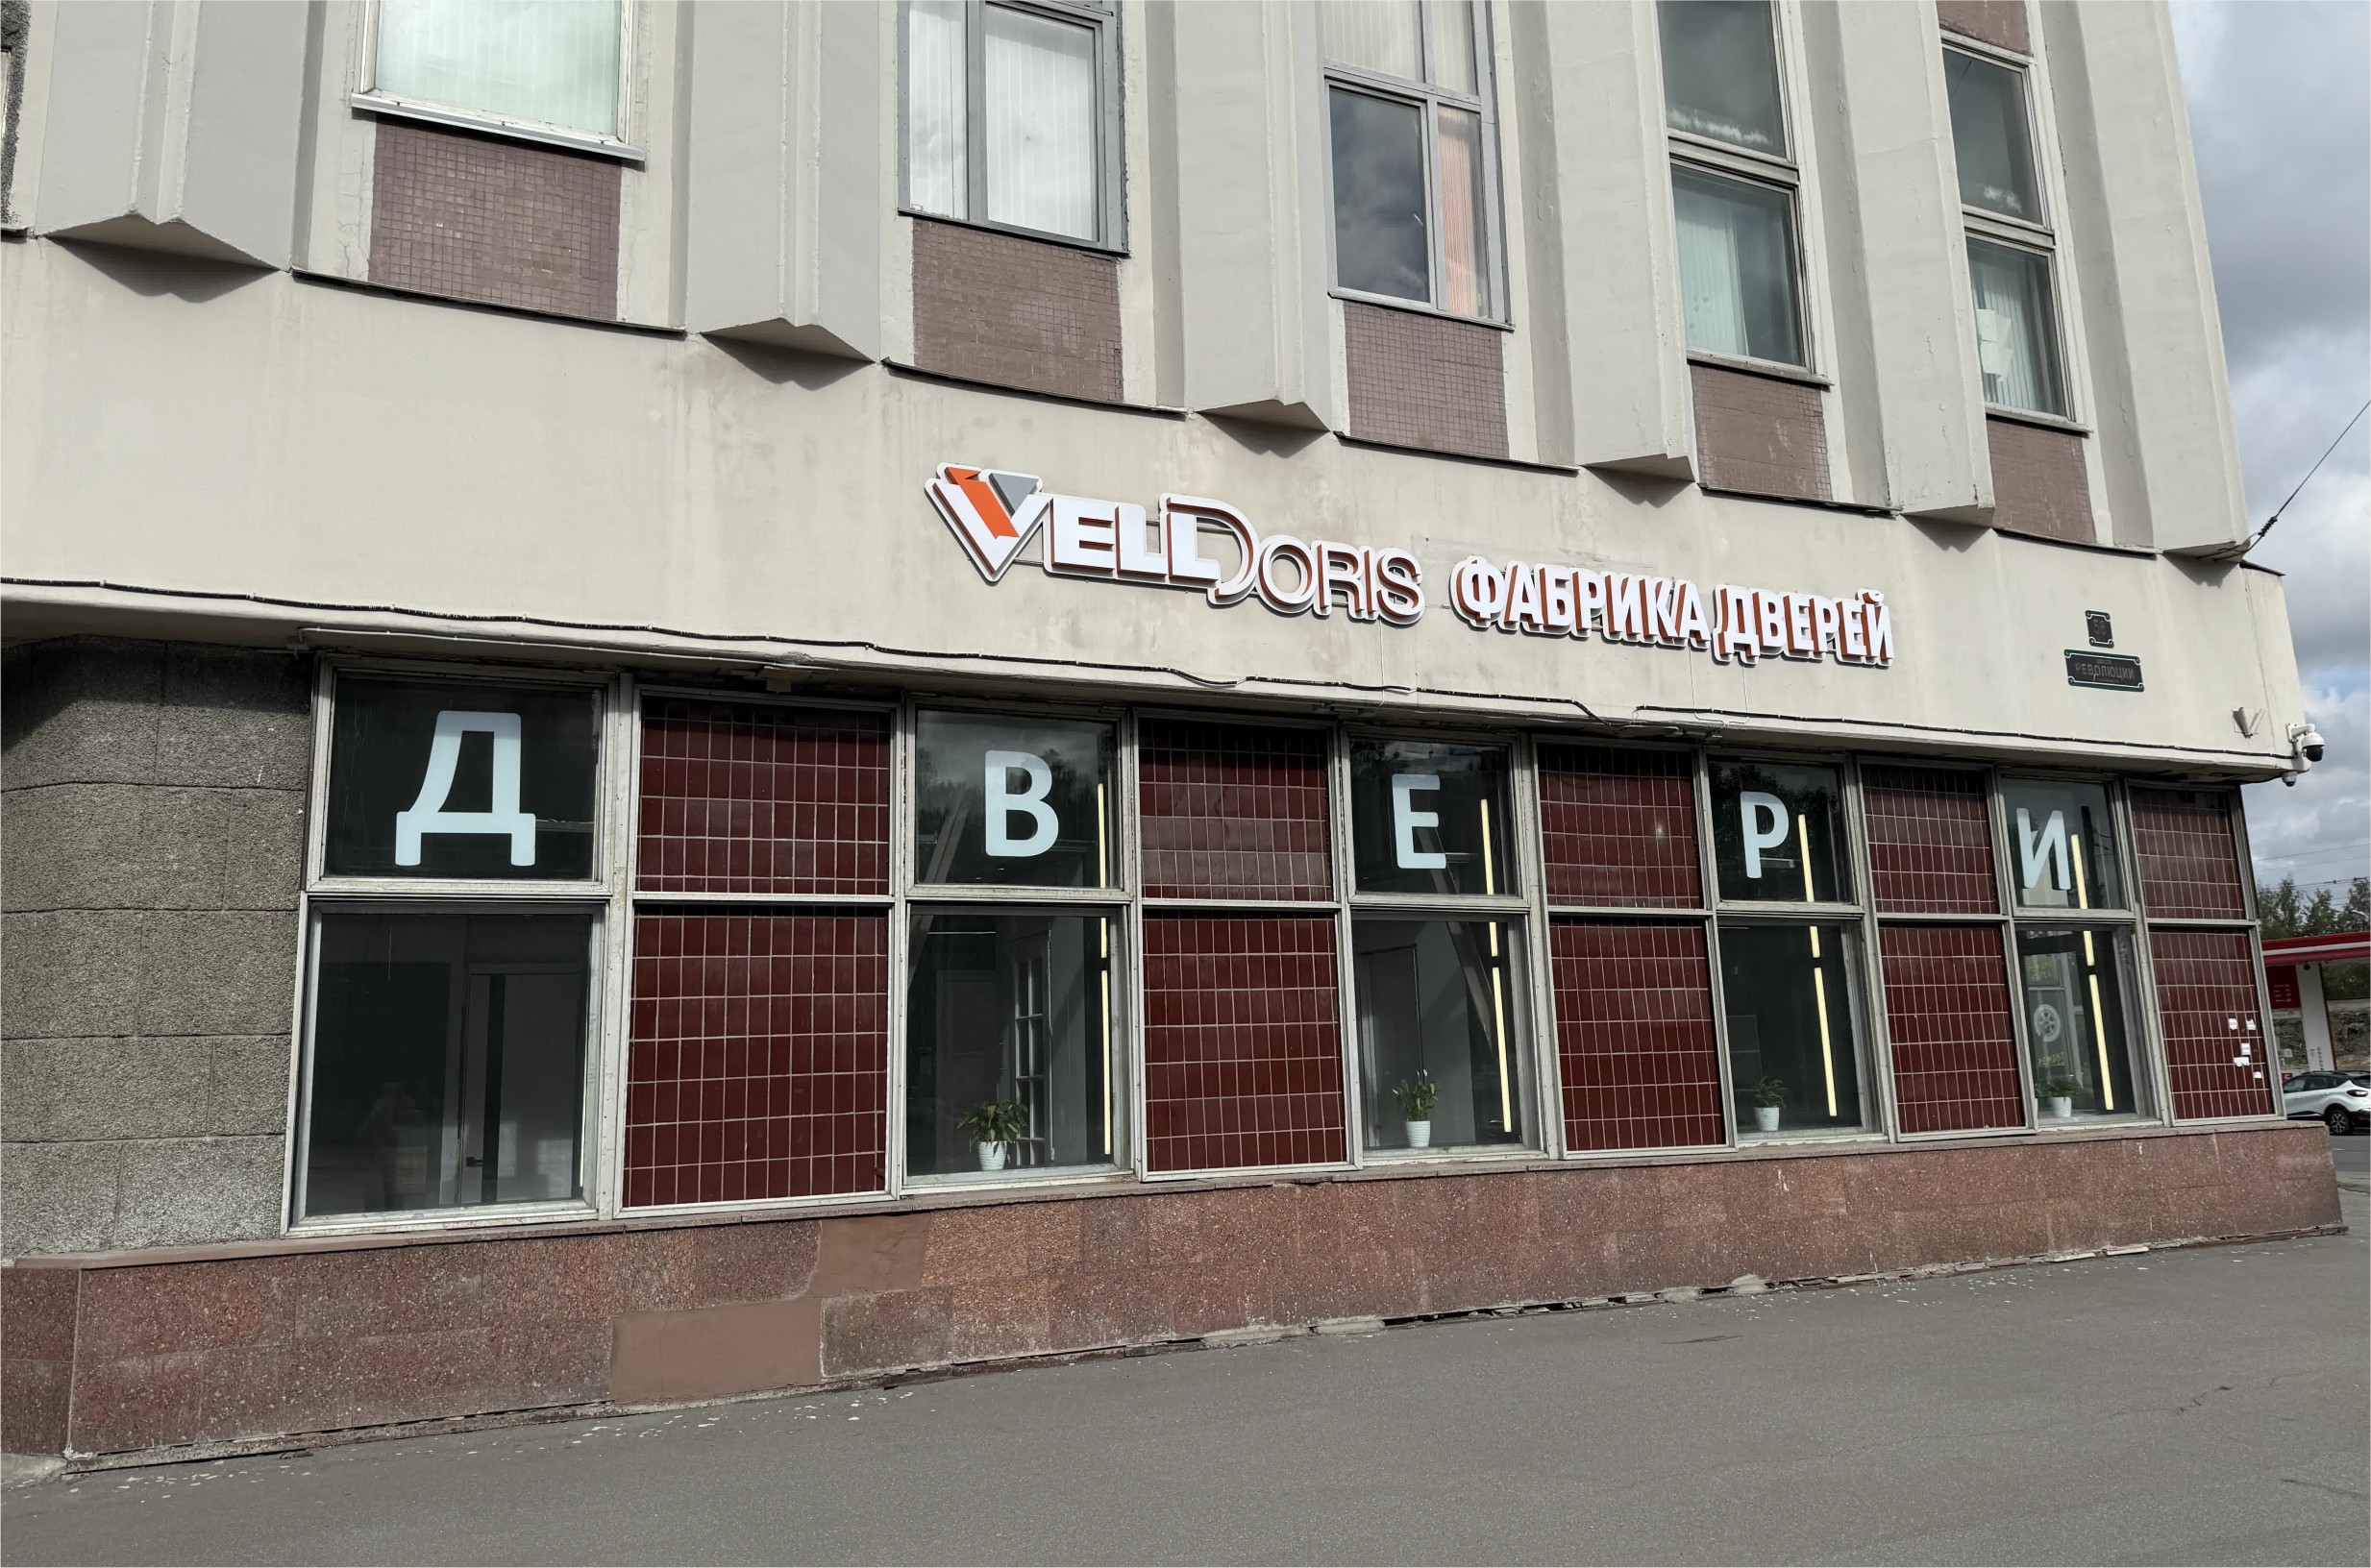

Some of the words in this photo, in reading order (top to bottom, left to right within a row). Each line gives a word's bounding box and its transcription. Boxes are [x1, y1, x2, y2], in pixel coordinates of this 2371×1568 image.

[1451, 555, 1712, 650] ФАБРИКА
[1713, 587, 1896, 667] ДВЕРЕЙ
[2075, 662, 2136, 680] РЕВОЛЮЦИИ
